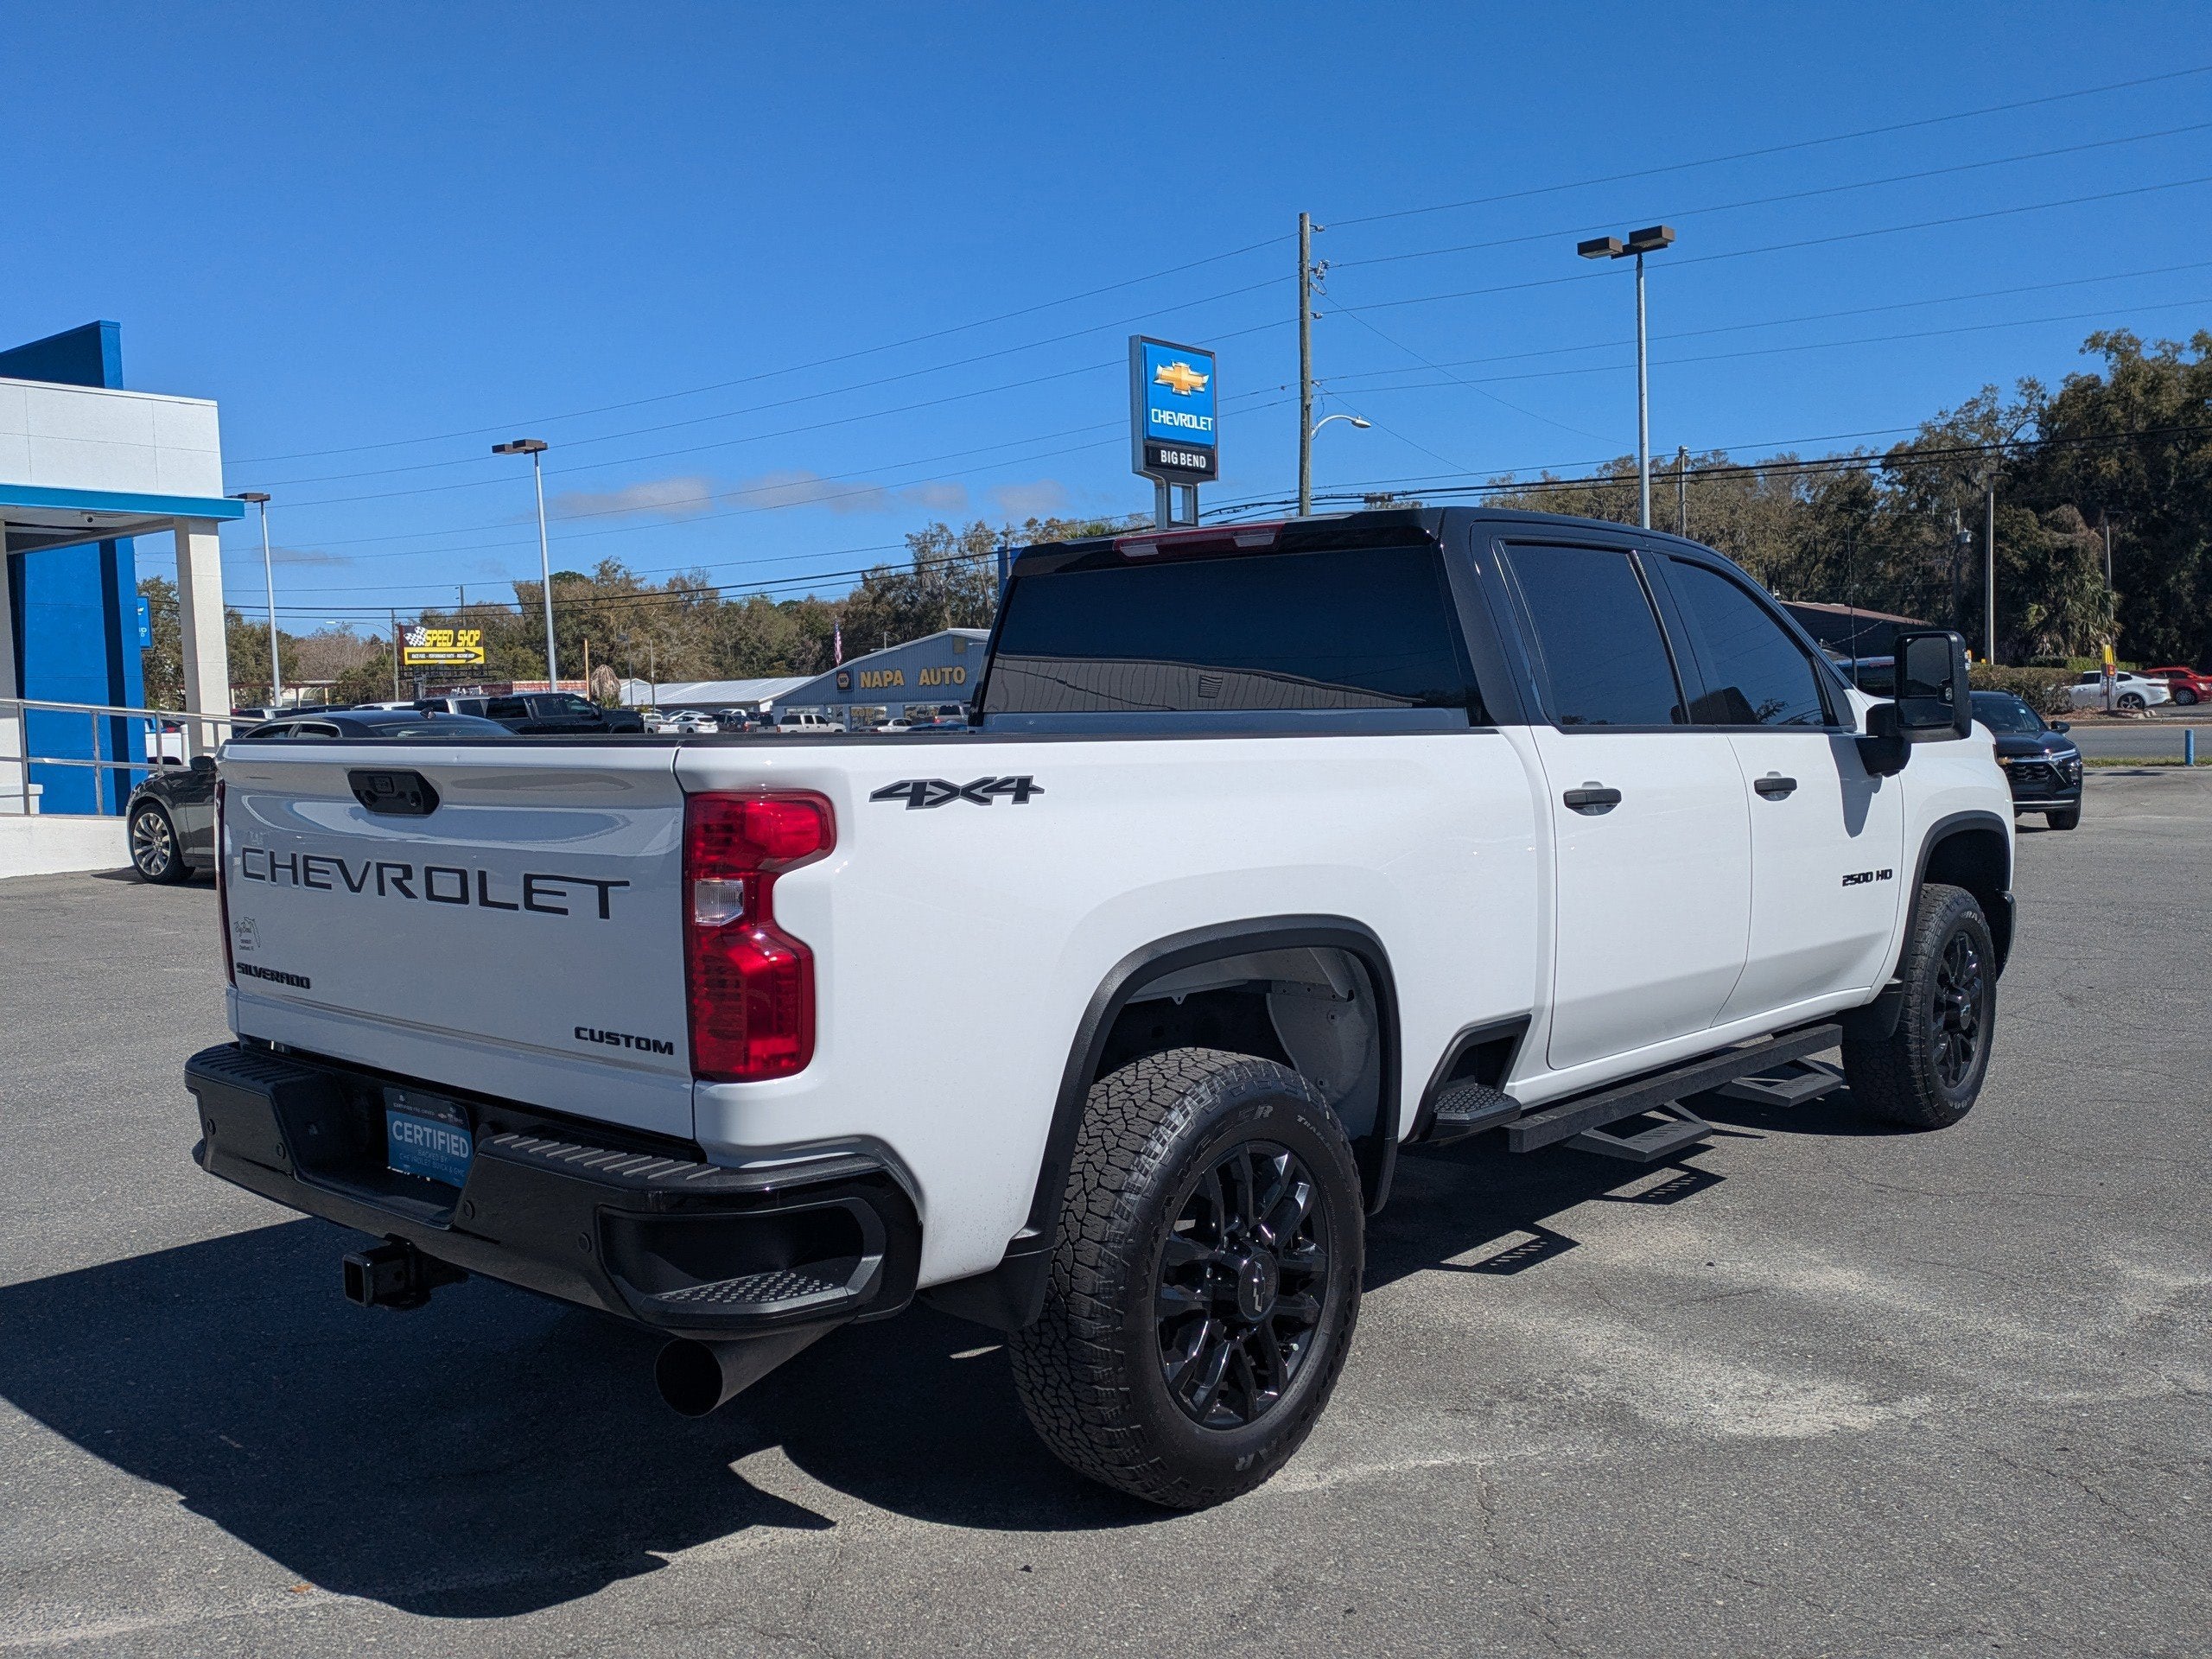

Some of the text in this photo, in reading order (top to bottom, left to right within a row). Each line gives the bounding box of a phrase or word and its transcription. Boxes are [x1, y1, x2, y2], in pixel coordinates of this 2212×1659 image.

[1151, 408, 1213, 431] CHEVROLET
[1160, 449, 1206, 468] BIG BEND
[424, 629, 480, 647] SPEED SHOP
[860, 670, 905, 689] NAPA
[918, 666, 966, 686] AUTO
[242, 847, 631, 919] CHEVROLET
[1842, 868, 1892, 887] 2500 HD
[236, 962, 311, 990] SILVERADO
[575, 1027, 674, 1056] CUSTOM
[392, 1120, 469, 1158] CERTIFIED
